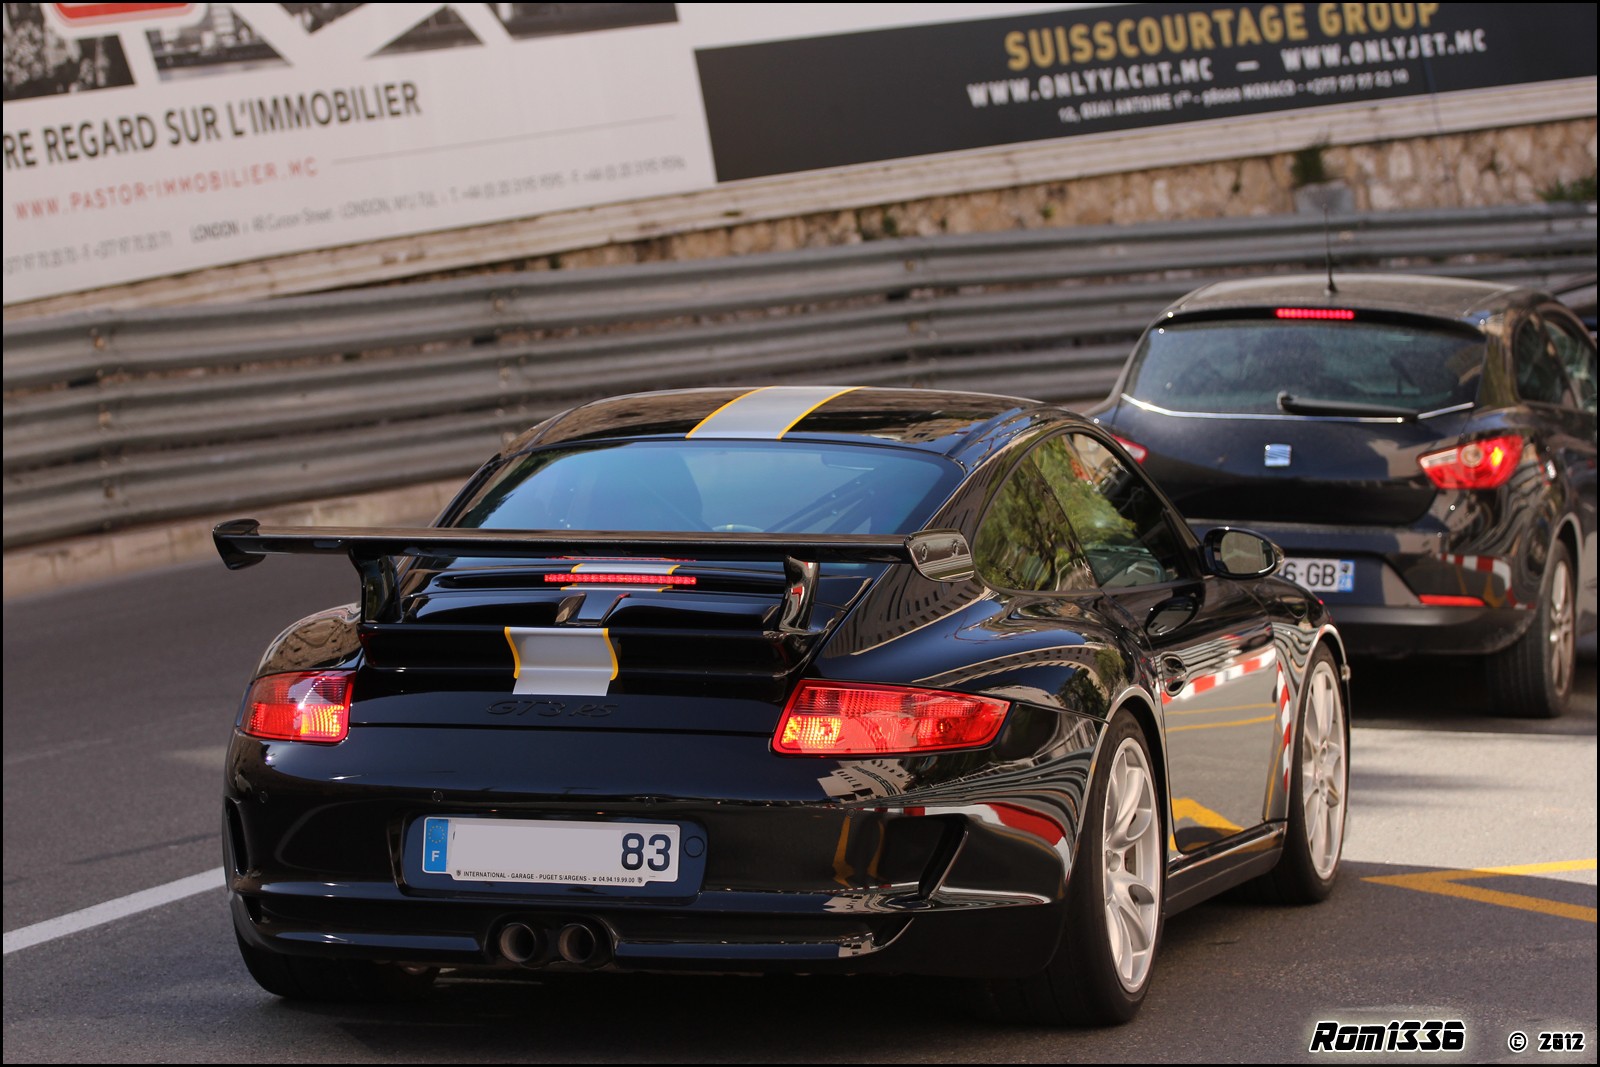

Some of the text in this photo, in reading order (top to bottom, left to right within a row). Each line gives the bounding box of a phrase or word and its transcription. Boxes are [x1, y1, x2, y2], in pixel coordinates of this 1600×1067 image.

[1004, 3, 1439, 71] SUISSCOURTAGE GROUP
[967, 29, 1487, 107] WWW.ONLYYACHT.MC WWW.ONLYJET.MC
[1080, 98, 1114, 120] QUAI
[1114, 93, 1173, 116] ANTOINE
[1242, 79, 1296, 100] MONACO
[3, 80, 422, 170] RE REGARD SUR L'IMMOBILIER
[14, 156, 319, 220] WWW.PASTOR-IMMOBILIER.MC
[486, 700, 619, 718] GT3 RS
[431, 850, 440, 862] F
[621, 832, 671, 872] 83
[463, 871, 506, 879] INTERNATIONAL
[511, 872, 535, 880] GARAGE
[539, 873, 558, 881] PUGET
